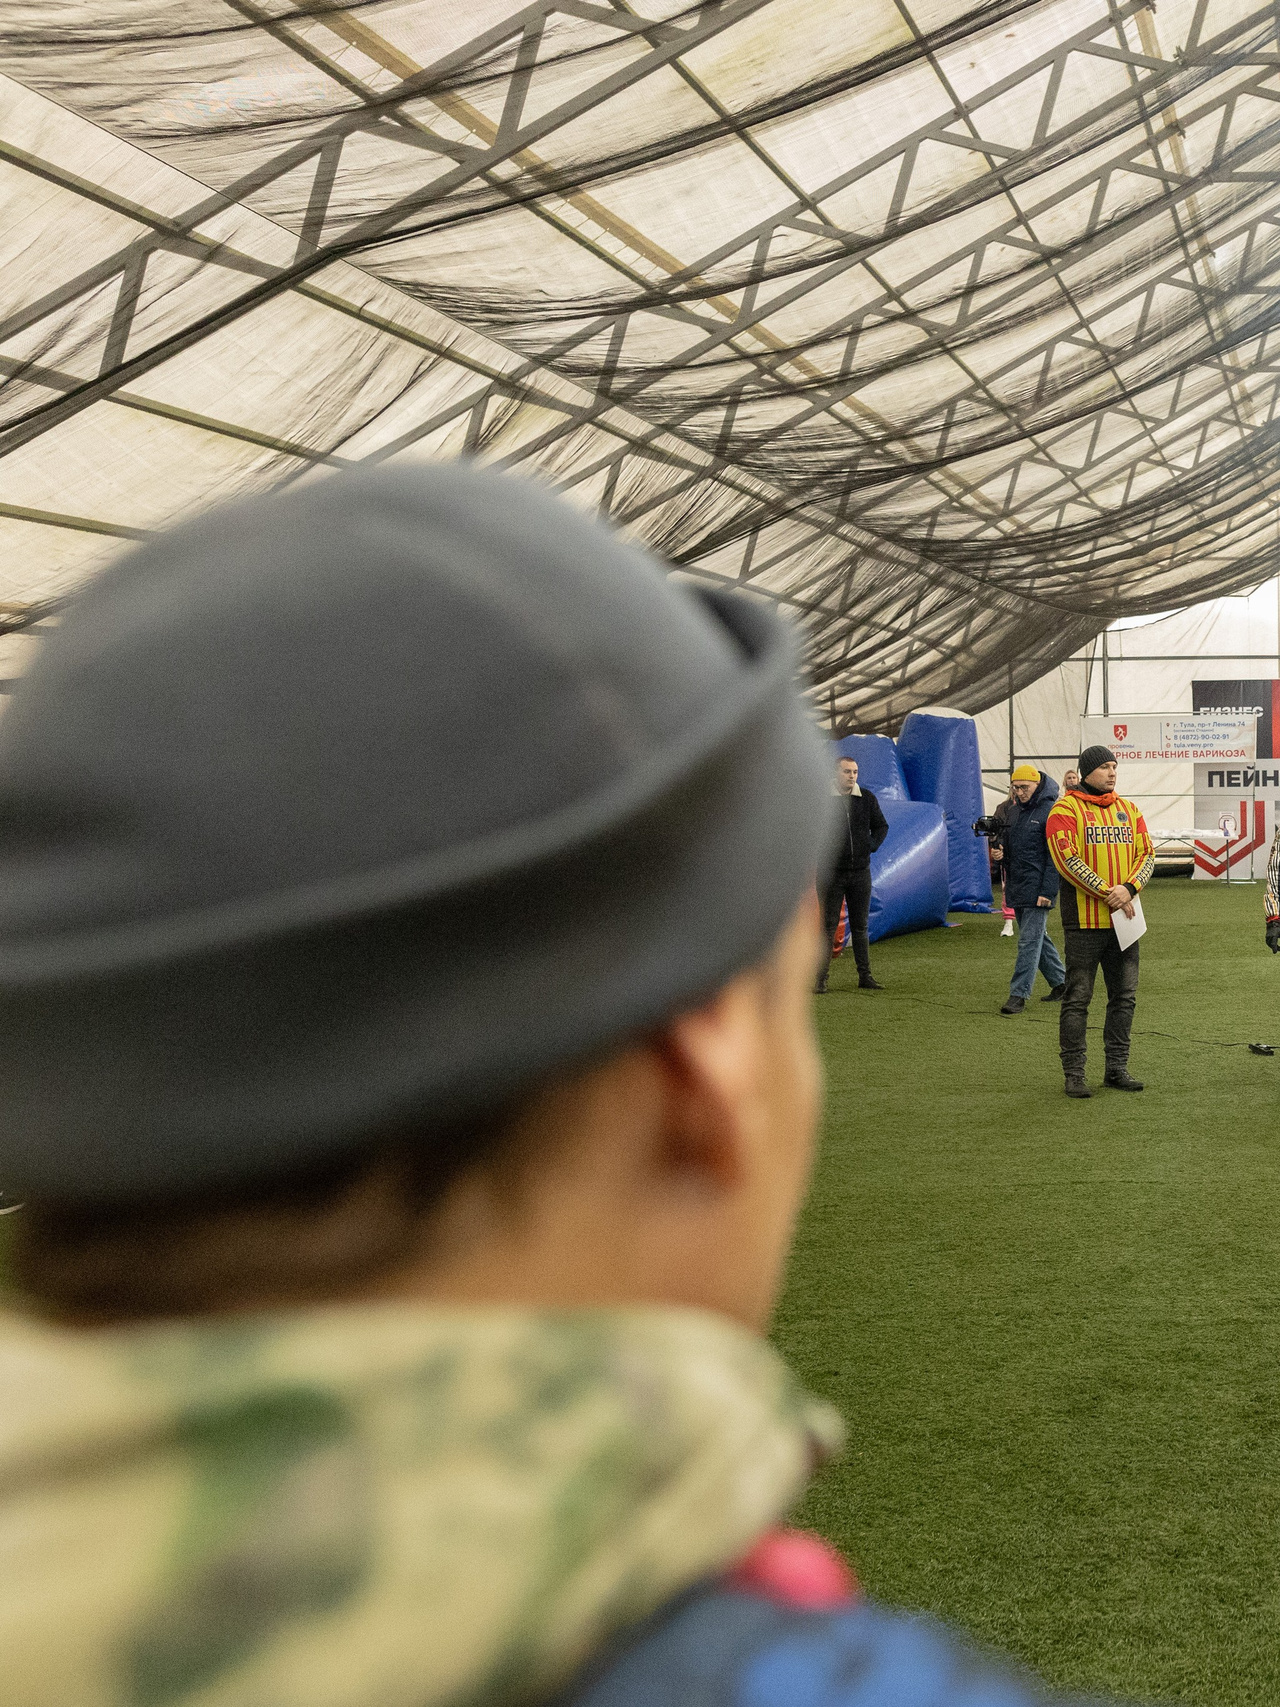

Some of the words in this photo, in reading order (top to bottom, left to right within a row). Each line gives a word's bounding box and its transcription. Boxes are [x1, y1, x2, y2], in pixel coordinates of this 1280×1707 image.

[1113, 751, 1142, 759] РНОЕ
[1144, 751, 1190, 759] ЛЕЧЕНИЕ
[1192, 749, 1246, 758] ВАРИКОЗА
[1086, 826, 1133, 844] REFEREE
[1065, 856, 1105, 891] REFEREE
